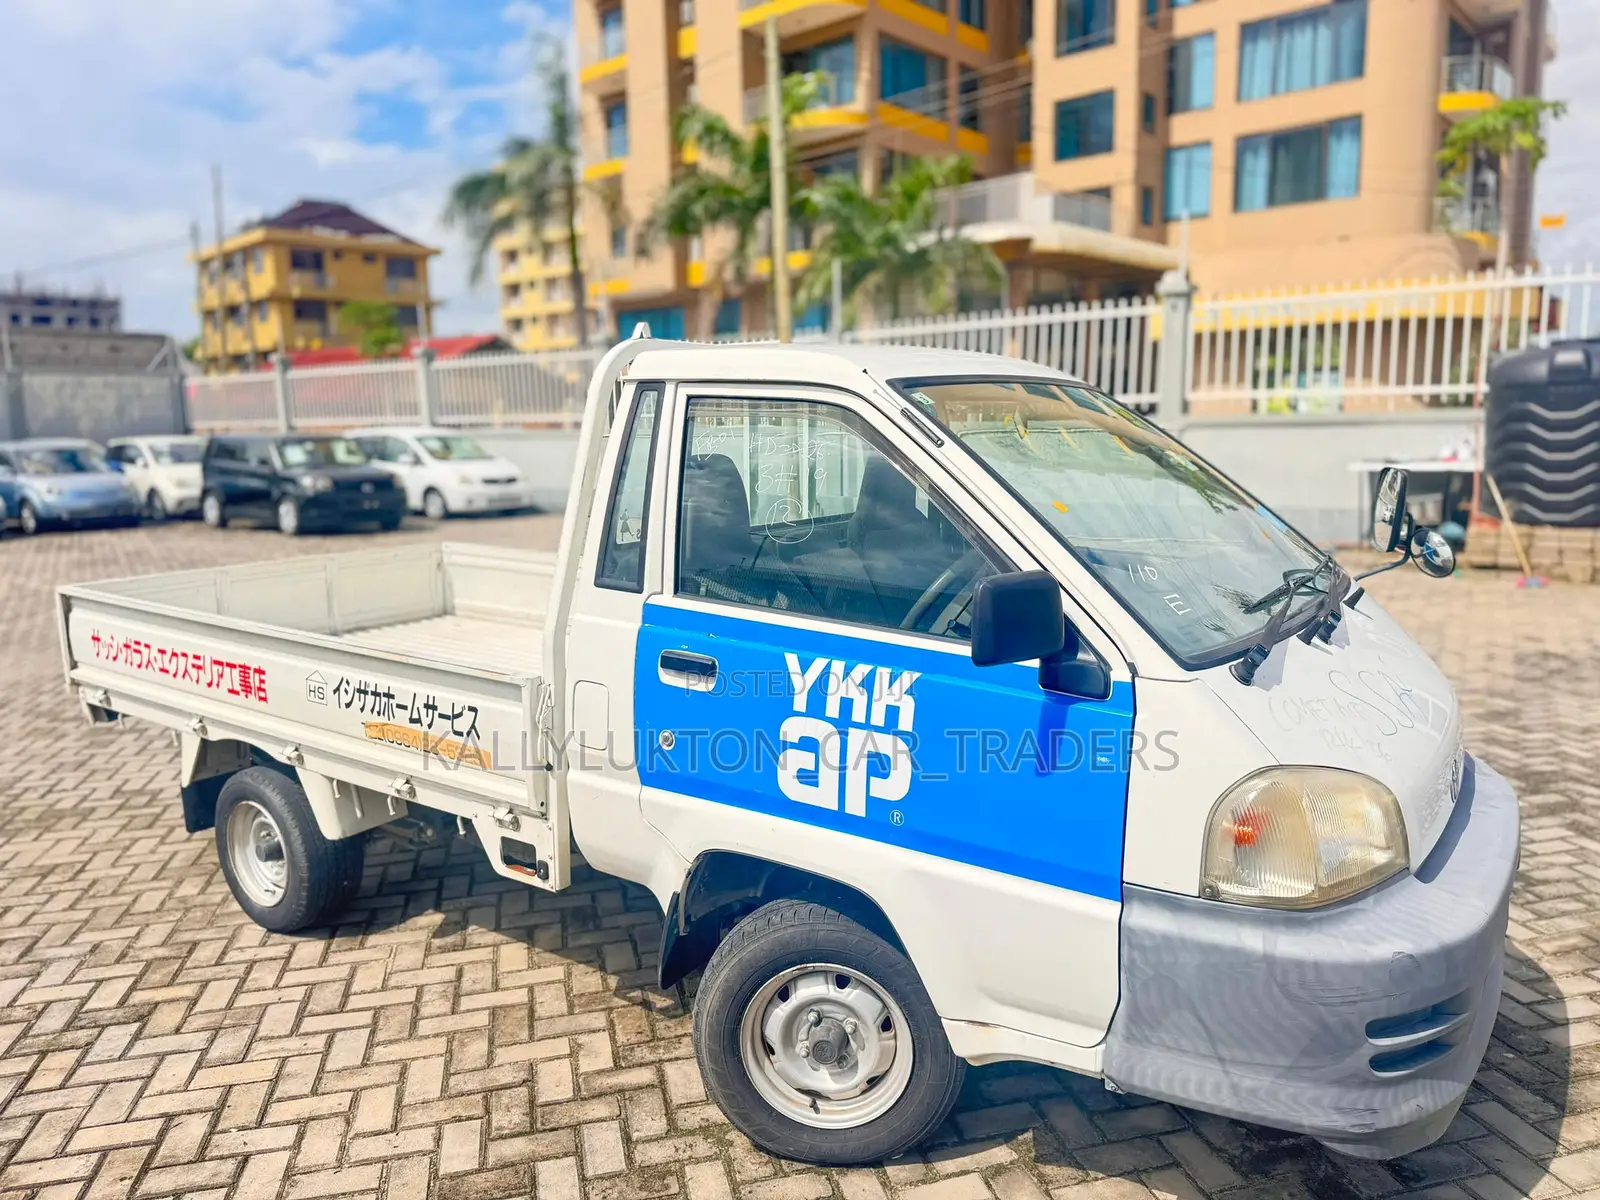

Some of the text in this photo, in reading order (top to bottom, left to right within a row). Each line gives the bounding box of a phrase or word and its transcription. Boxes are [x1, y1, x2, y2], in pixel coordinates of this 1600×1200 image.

[308, 683, 325, 700] HS
[333, 676, 481, 740] イシザカホームサービス
[783, 651, 923, 732] YKK
[777, 715, 912, 818] ap
